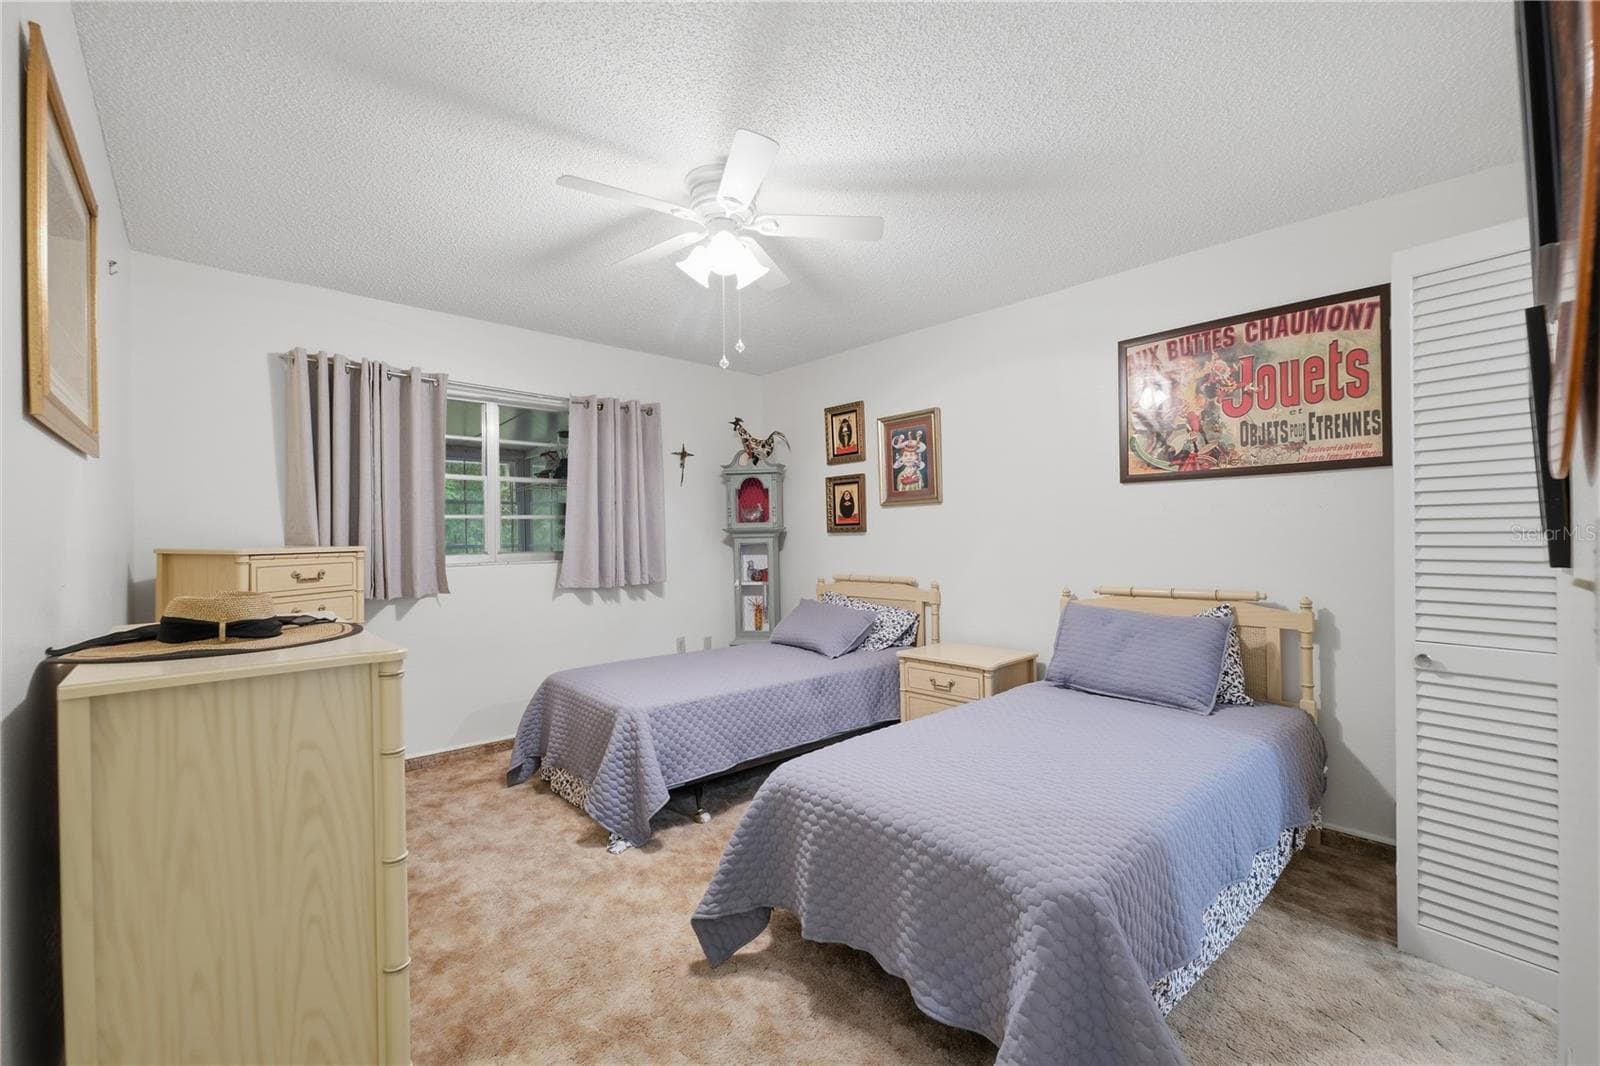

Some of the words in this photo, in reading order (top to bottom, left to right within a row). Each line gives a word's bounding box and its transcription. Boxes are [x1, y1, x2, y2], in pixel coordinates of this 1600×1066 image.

[1167, 326, 1235, 361] BUTTES
[1244, 302, 1381, 344] CHAUMONT
[1222, 339, 1369, 418] Jouets
[1240, 420, 1289, 447] OBJETS
[1308, 409, 1382, 441] ETRENNES
